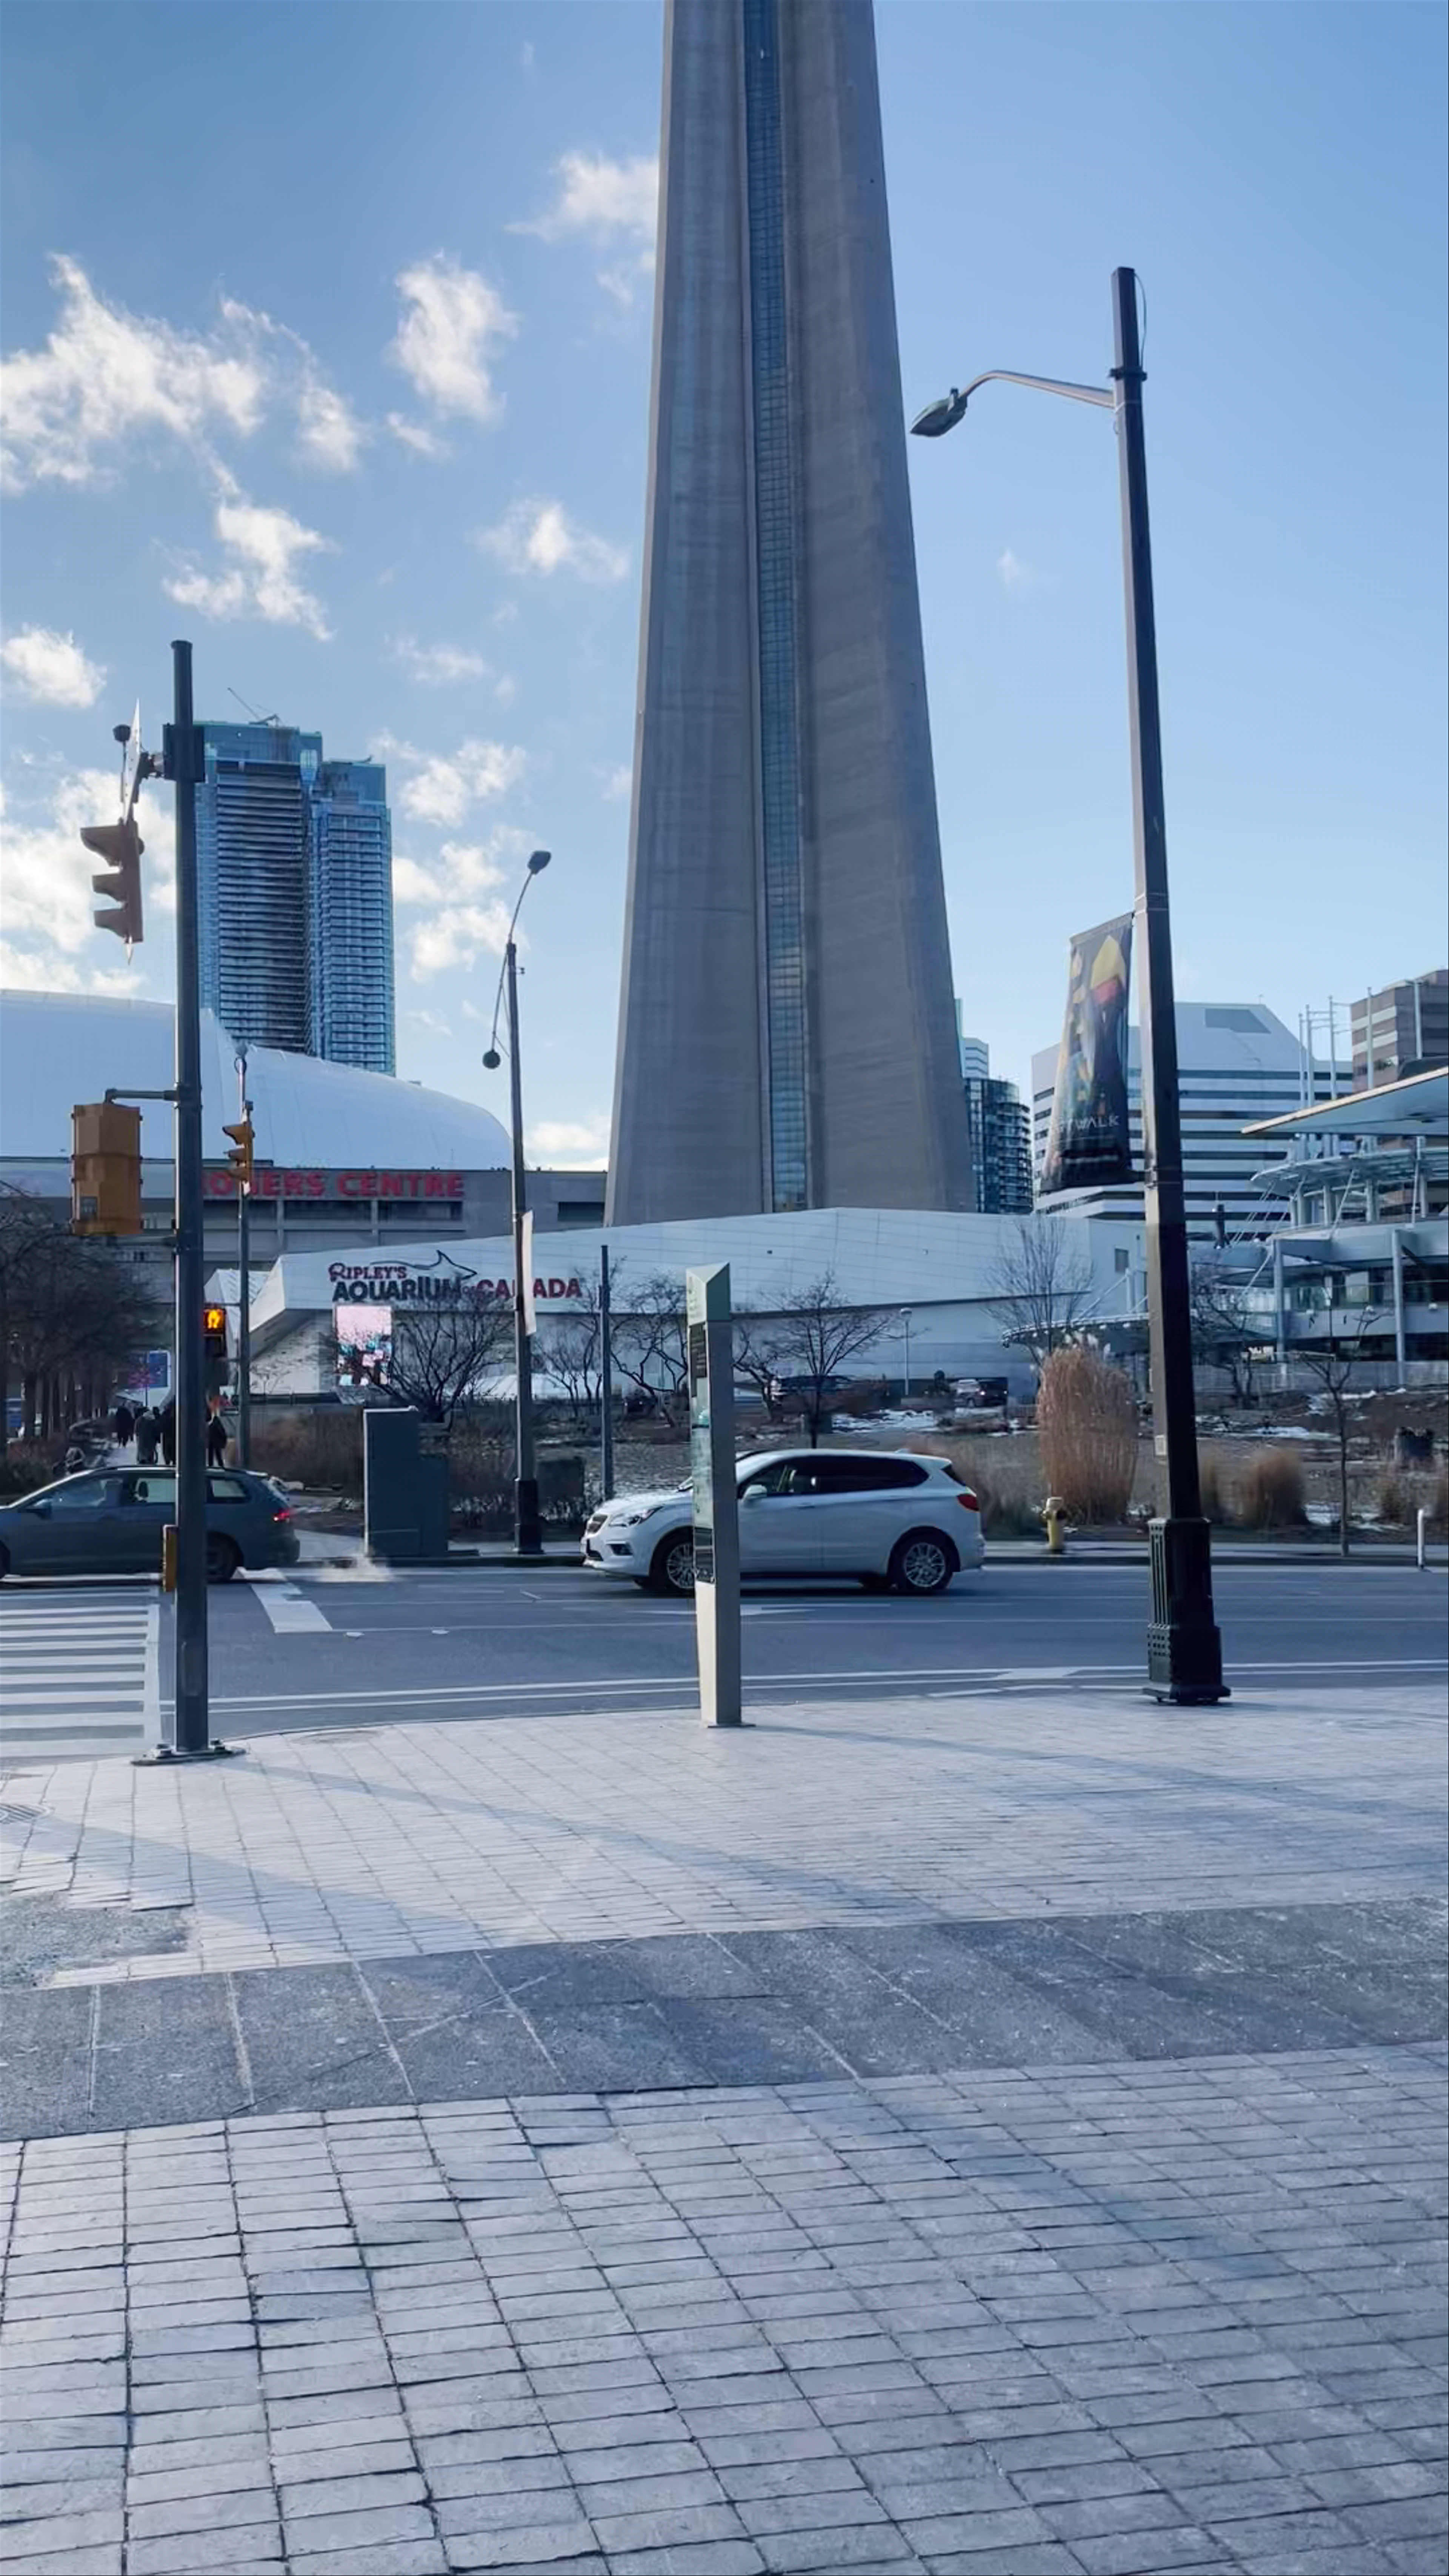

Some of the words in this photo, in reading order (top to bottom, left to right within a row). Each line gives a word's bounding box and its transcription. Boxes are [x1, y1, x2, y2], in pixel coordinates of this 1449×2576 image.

[337, 1172, 464, 1196] CENTRE
[328, 1263, 407, 1282] RIPLEY'S
[332, 1277, 461, 1303] AQUARIUM
[477, 1278, 582, 1298] CAADA
